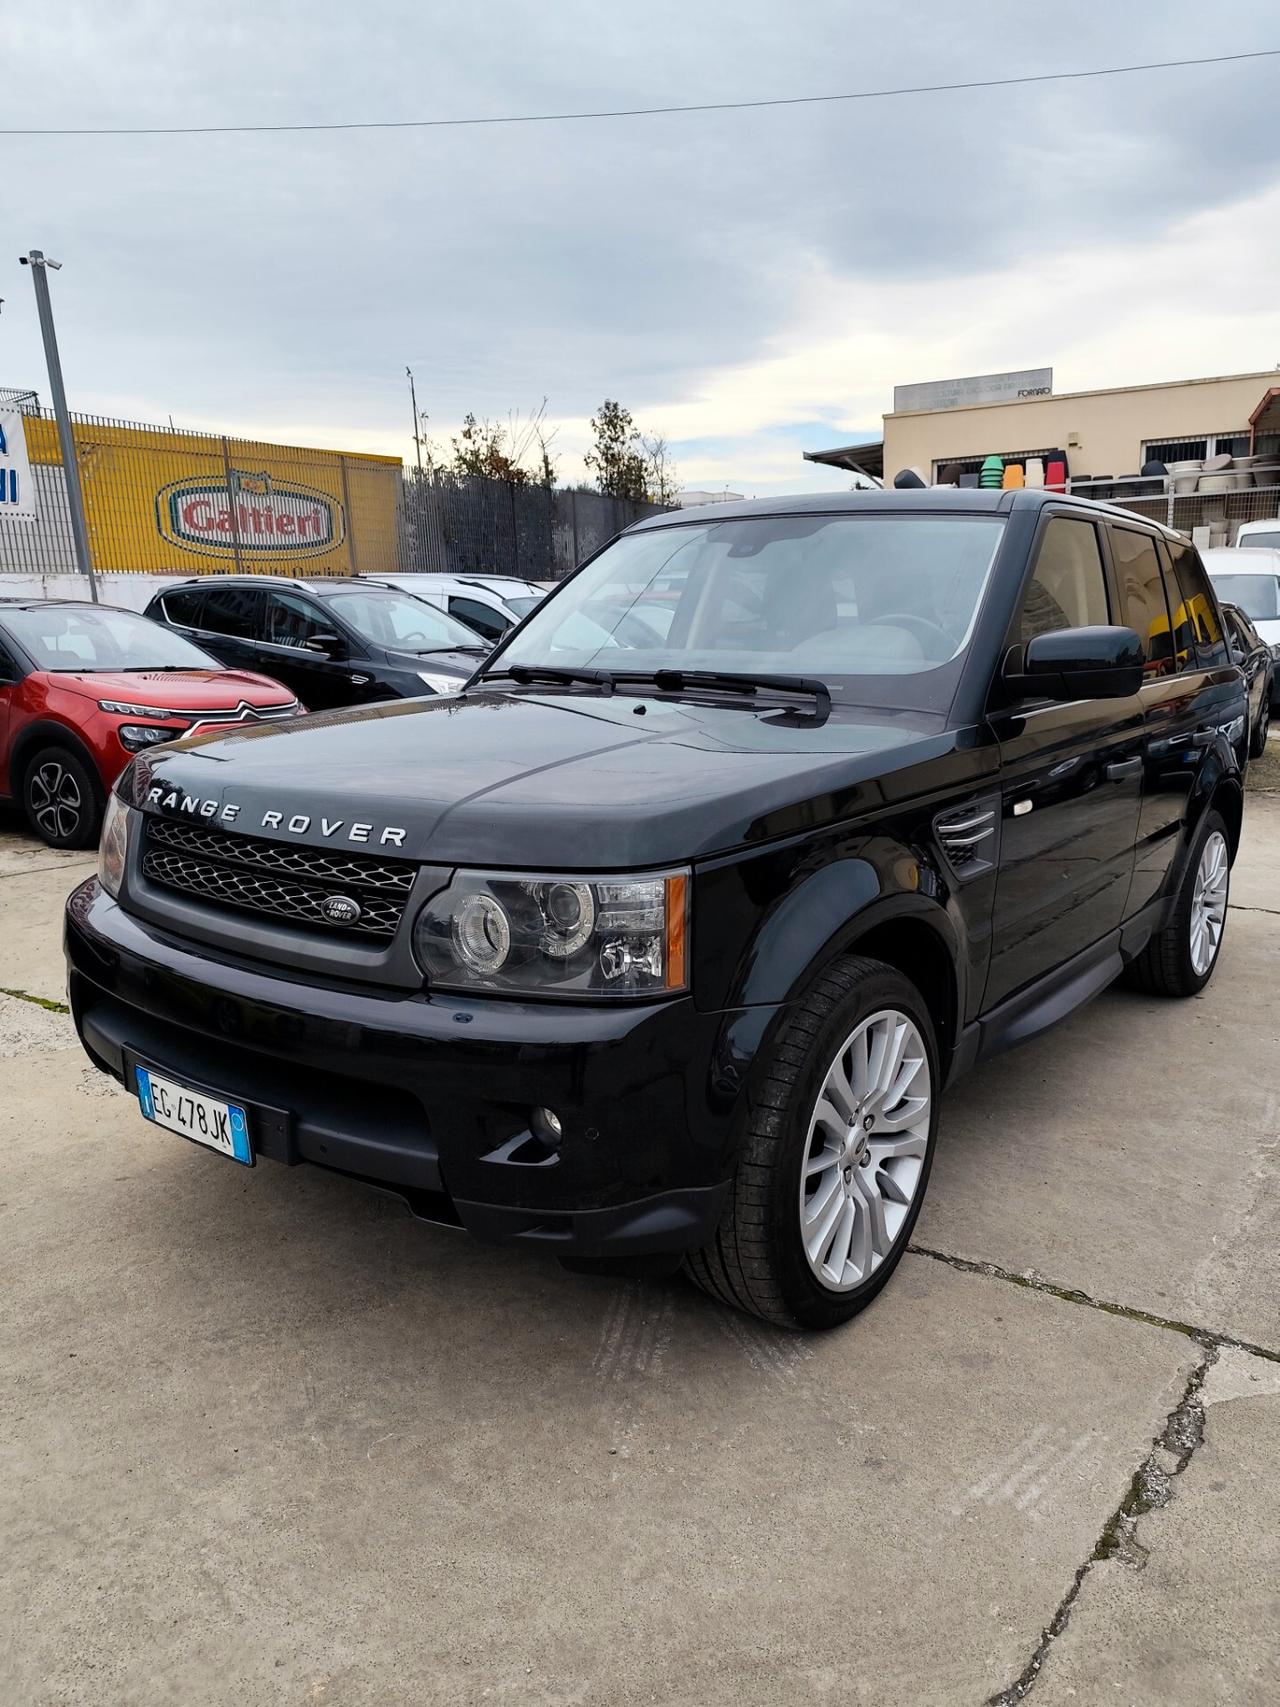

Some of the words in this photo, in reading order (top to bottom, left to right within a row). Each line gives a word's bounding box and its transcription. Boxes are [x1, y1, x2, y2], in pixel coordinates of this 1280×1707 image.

[182, 500, 321, 537] Galtieri
[148, 787, 241, 822] RANGE
[261, 811, 408, 848] ROVER
